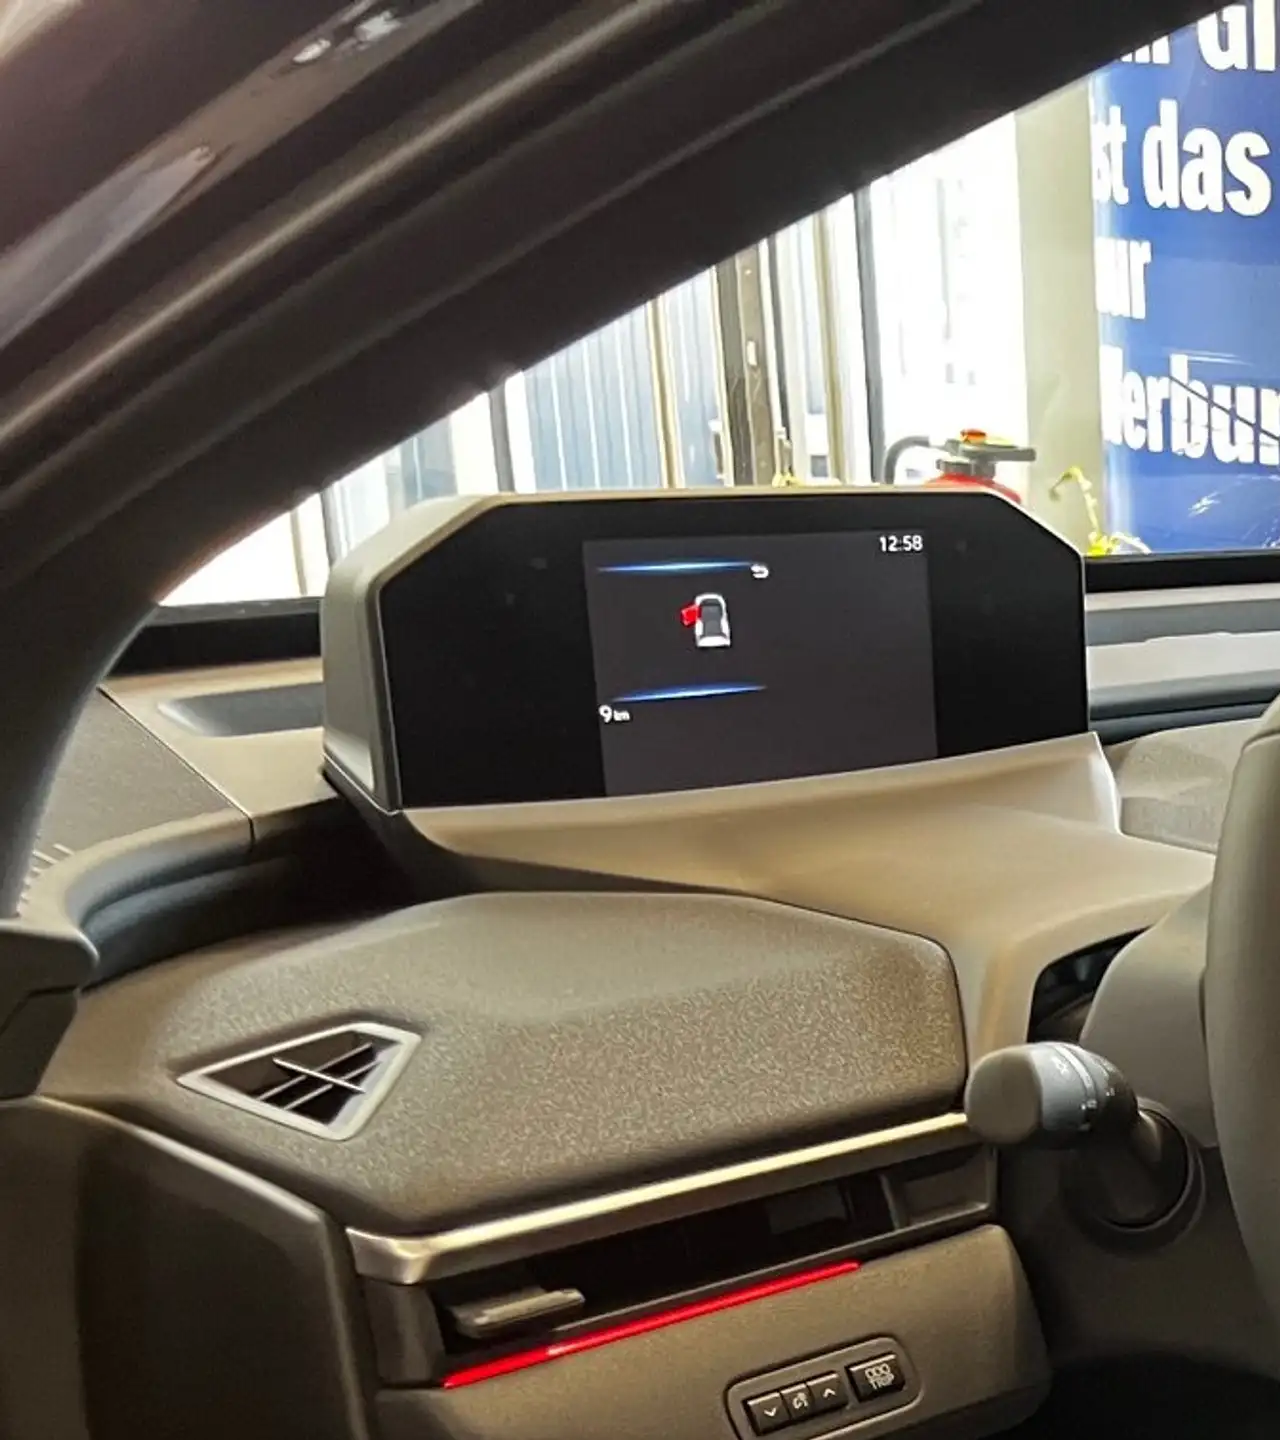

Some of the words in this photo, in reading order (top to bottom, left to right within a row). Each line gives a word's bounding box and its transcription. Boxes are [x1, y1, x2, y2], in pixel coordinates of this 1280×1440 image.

[1142, 98, 1273, 217] das
[879, 534, 924, 552] 12:58
[598, 704, 613, 723] 9
